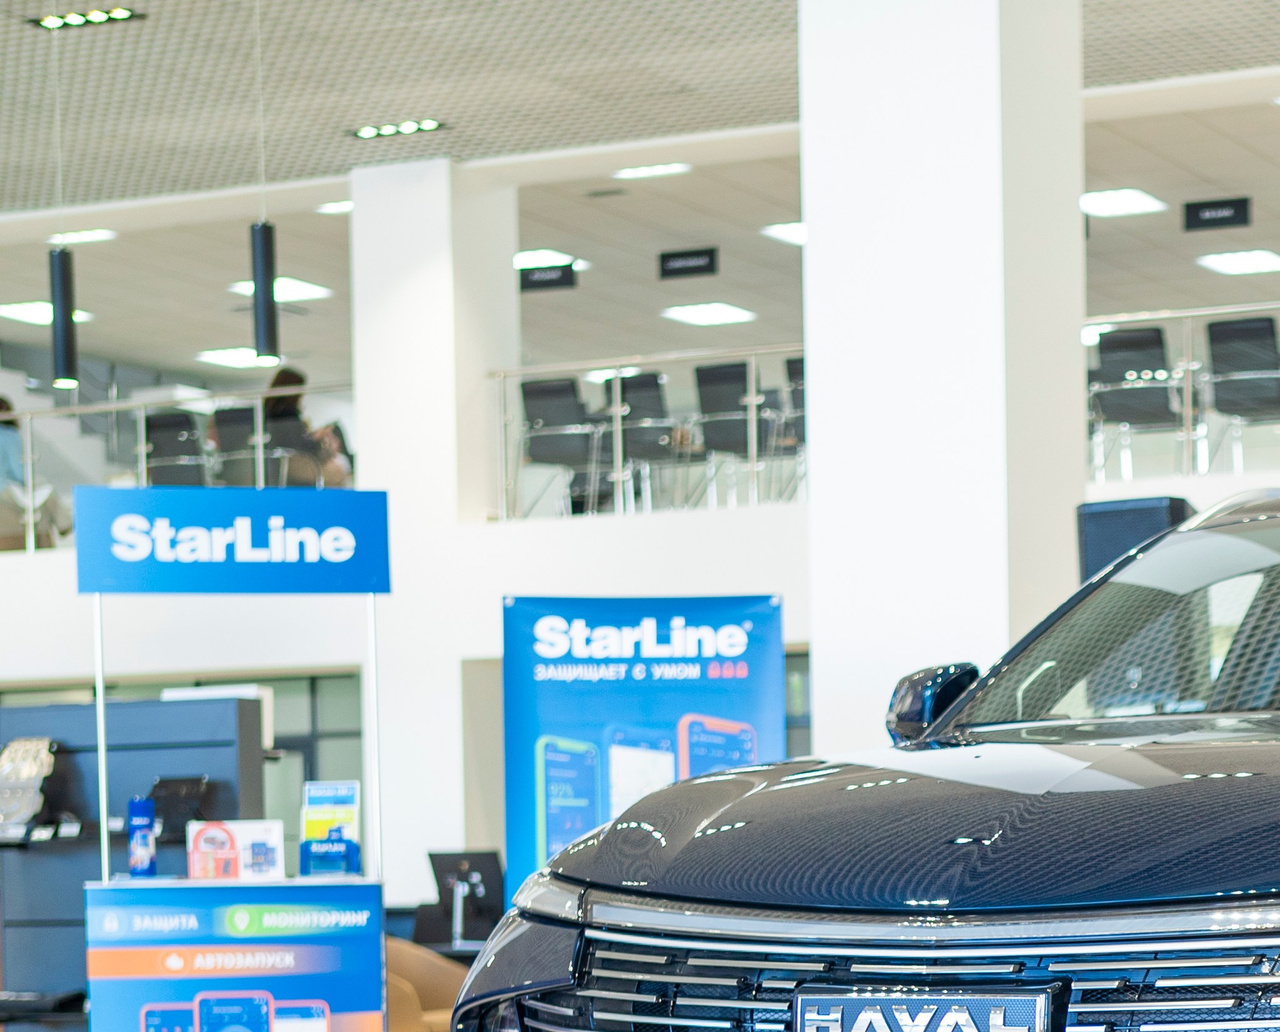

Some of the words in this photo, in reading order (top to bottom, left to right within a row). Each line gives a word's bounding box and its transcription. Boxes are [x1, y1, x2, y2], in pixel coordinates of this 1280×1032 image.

[110, 513, 357, 563] StarLine
[533, 615, 749, 659] StarLine
[533, 663, 628, 682] ЗАЩИЩАЕТ
[632, 663, 646, 680] С
[652, 663, 701, 680] УМОМ
[132, 913, 199, 933] ЗАЩИТА
[262, 910, 370, 929] МОНИТОРИНГ
[193, 951, 296, 970] АВТОЗАПУСК
